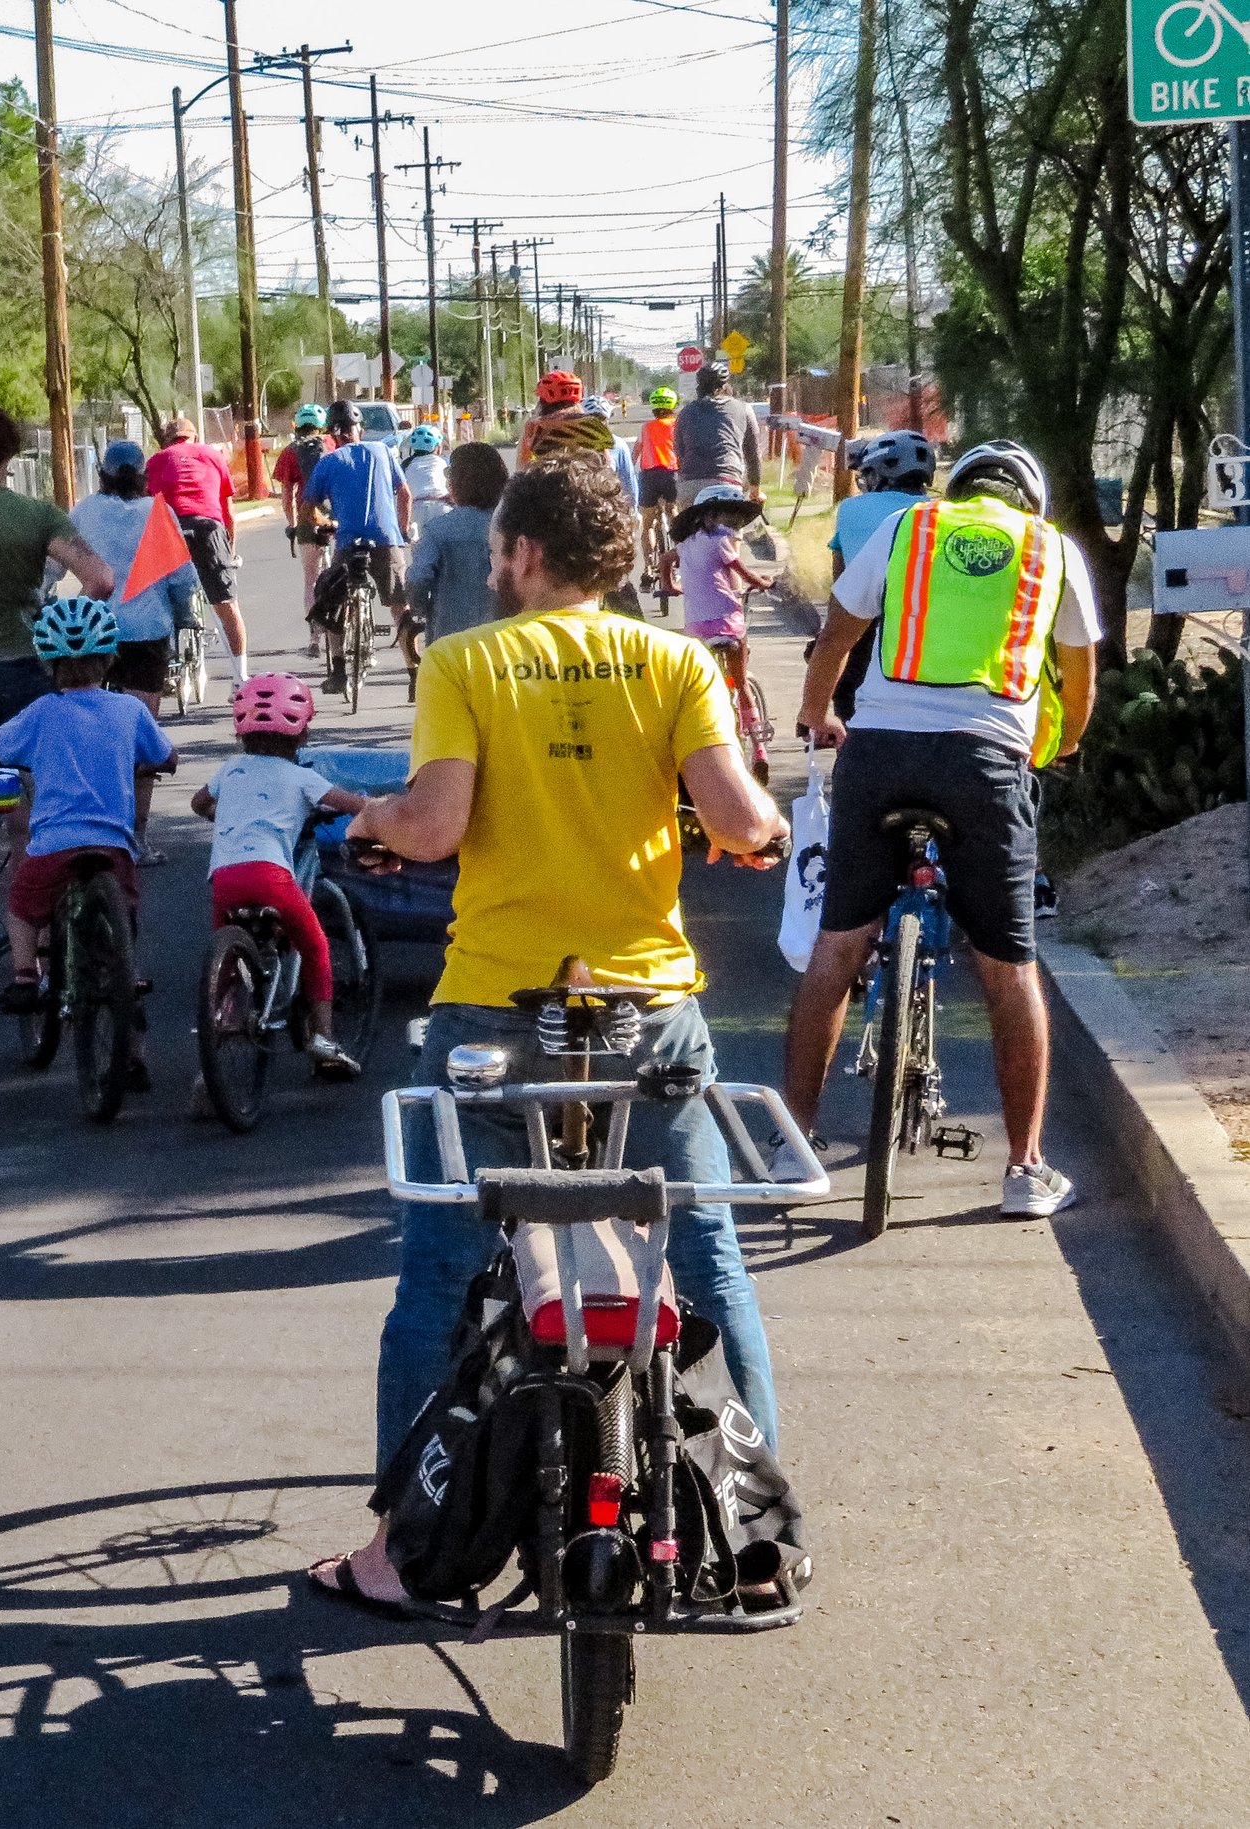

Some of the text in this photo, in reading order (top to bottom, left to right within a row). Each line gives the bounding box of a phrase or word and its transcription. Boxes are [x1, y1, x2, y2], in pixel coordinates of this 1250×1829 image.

[1151, 77, 1221, 112] BIKE
[679, 353, 702, 365] STOP
[493, 656, 646, 682] volunteer
